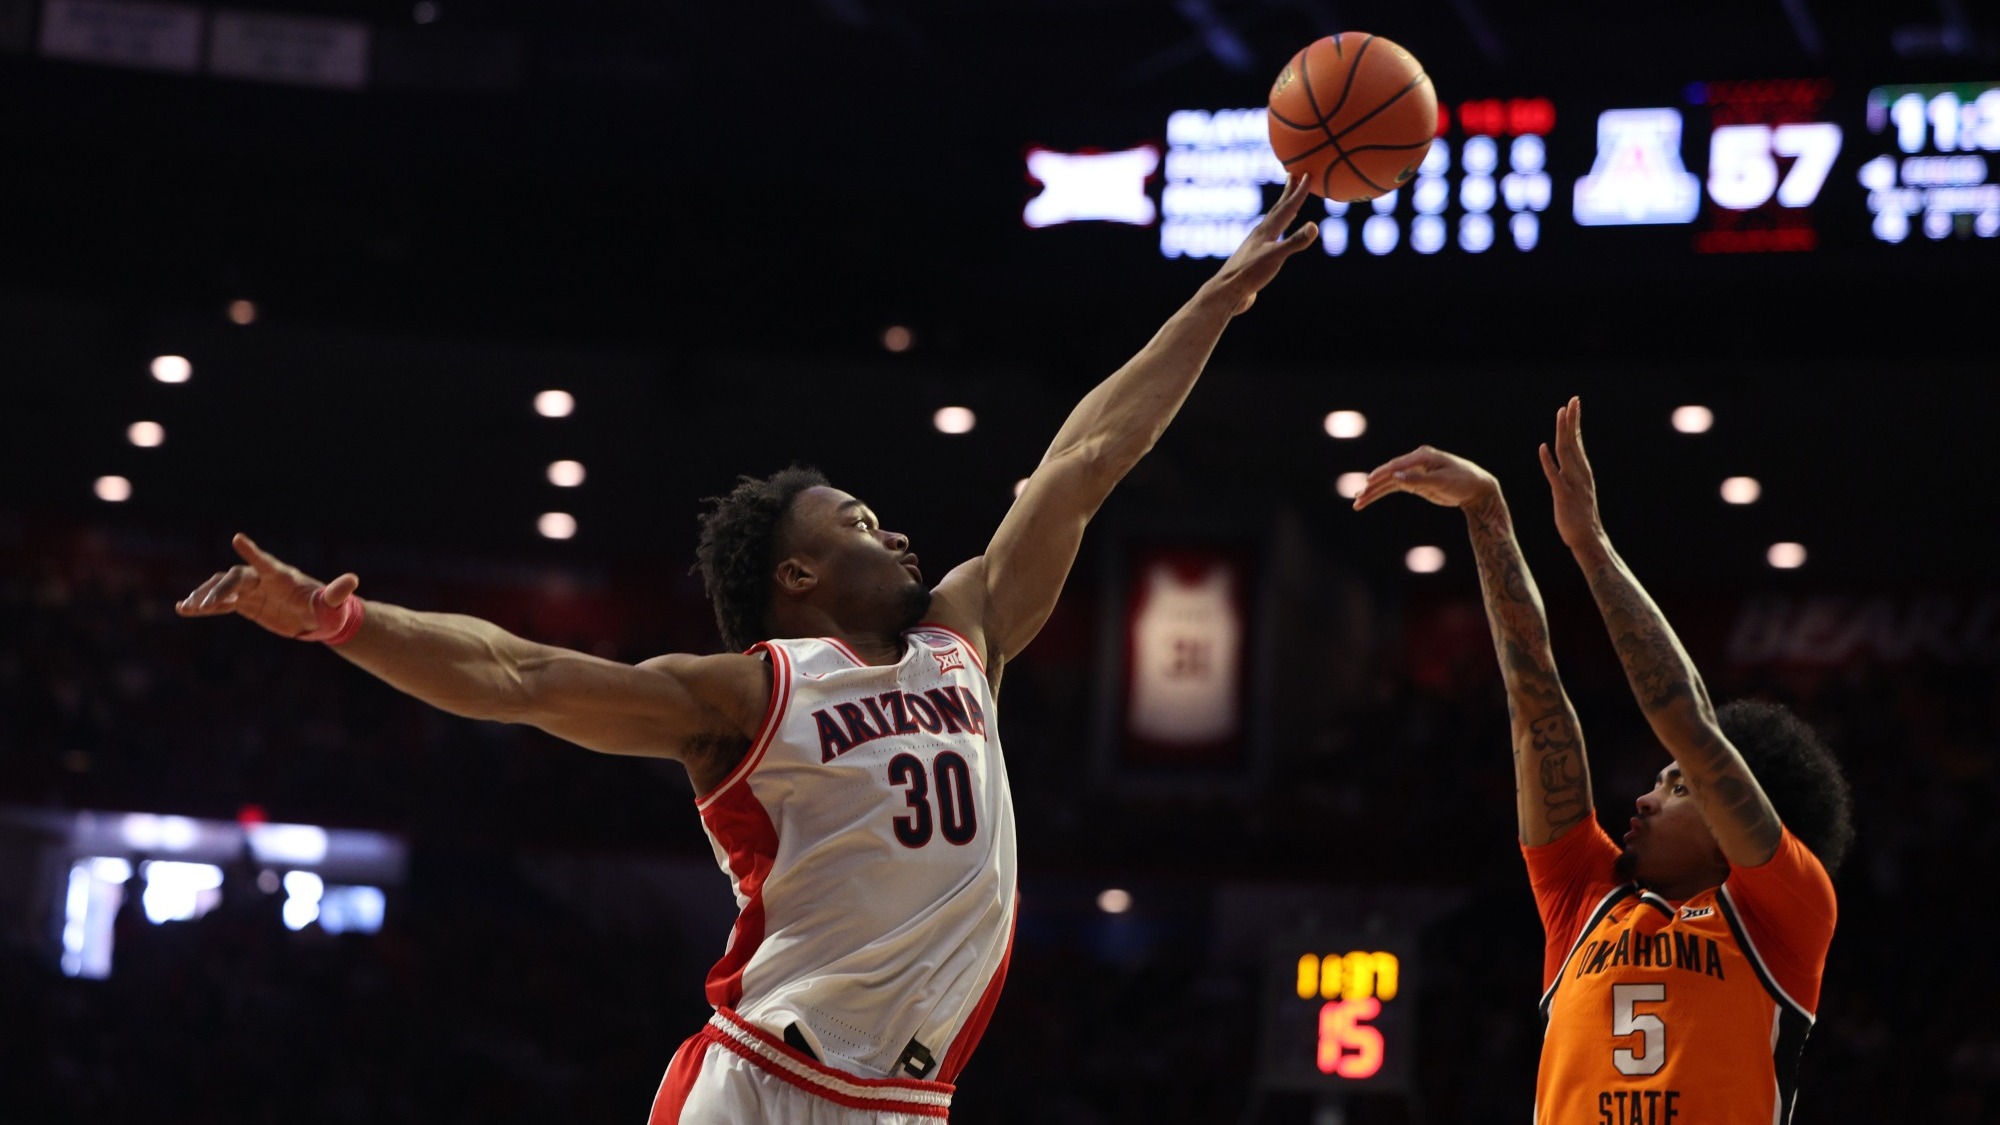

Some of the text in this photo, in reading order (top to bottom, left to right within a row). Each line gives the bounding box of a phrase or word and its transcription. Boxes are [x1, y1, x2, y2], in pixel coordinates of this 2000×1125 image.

[1707, 123, 1844, 210] 57
[811, 685, 988, 765] ARIZONA
[888, 750, 978, 849] 30
[1576, 928, 1725, 981] OKAHOMA
[1317, 997, 1385, 1078] 15
[1612, 983, 1665, 1075] 5
[1599, 1090, 1680, 1125] STATE
